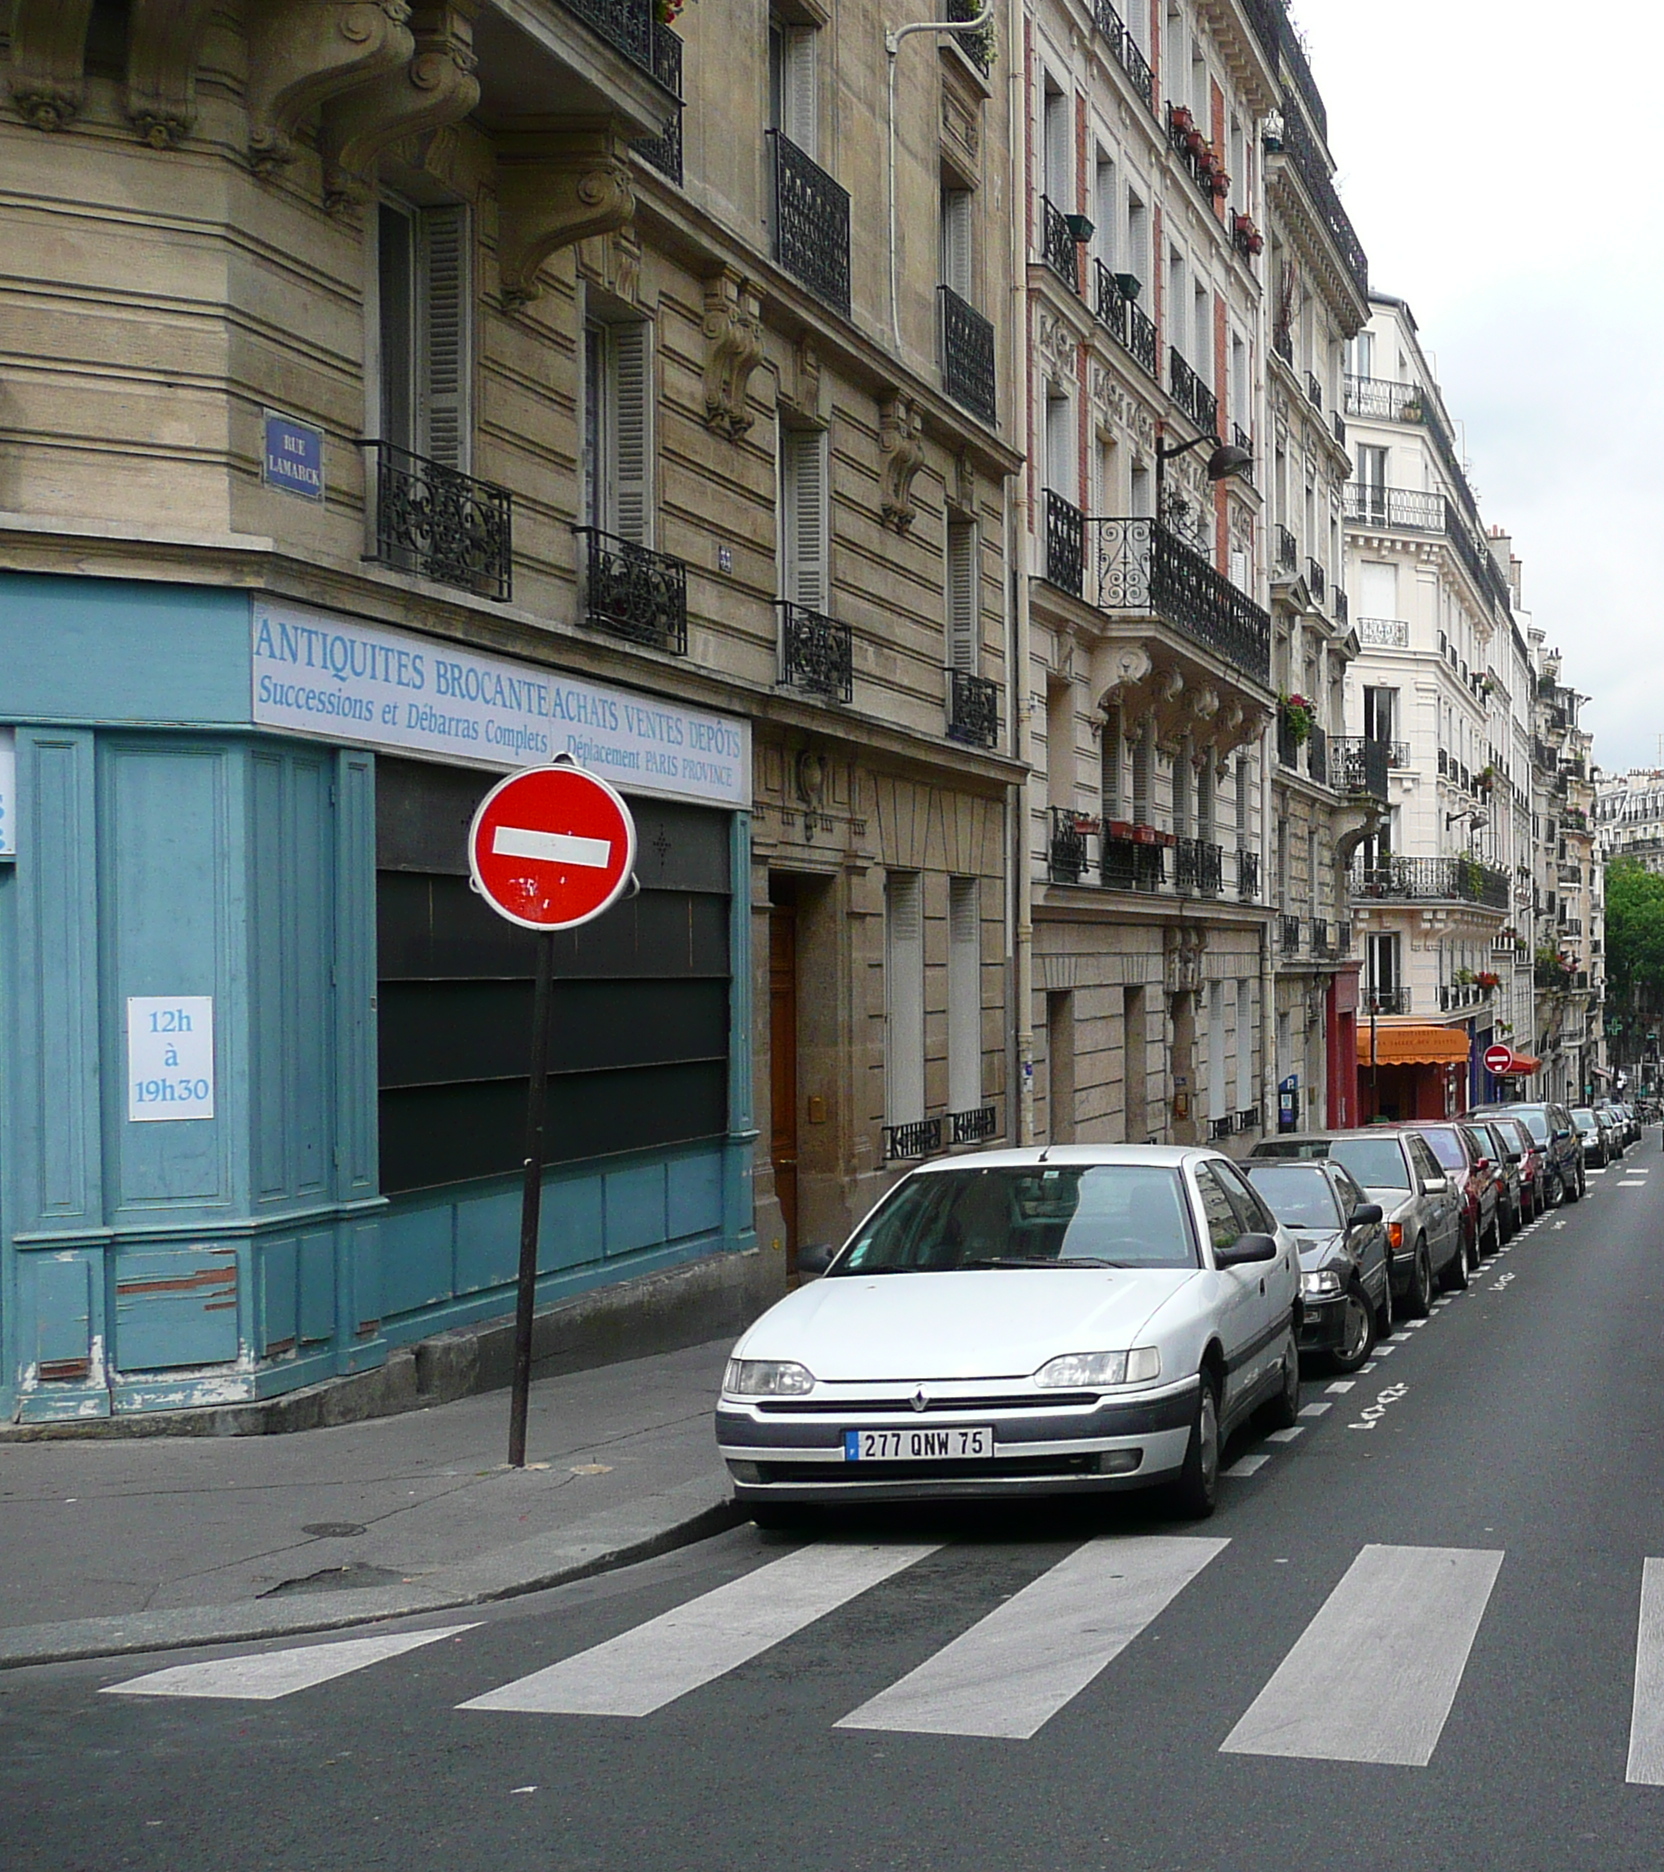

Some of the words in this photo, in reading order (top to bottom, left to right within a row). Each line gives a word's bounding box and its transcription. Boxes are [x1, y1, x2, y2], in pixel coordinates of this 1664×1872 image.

[284, 434, 305, 456] RUE
[269, 454, 319, 486] LAMARCK
[255, 618, 425, 690] ANTIQUITES
[435, 660, 548, 717] BROCANTE
[552, 687, 619, 732] ACHATS
[624, 704, 684, 746] VENTES
[259, 675, 374, 722] Successions
[382, 701, 398, 726] et
[406, 702, 479, 741] Débarras
[485, 719, 548, 756] Complets
[566, 733, 640, 770] Déplacement
[645, 750, 678, 776] PARIS
[682, 758, 732, 788] PROVINCE
[149, 1008, 193, 1033] 12h
[164, 1042, 179, 1067] à
[135, 1078, 210, 1102] 19h30
[865, 1433, 901, 1457] 277
[911, 1432, 949, 1457] QNW
[959, 1431, 983, 1455] 75
